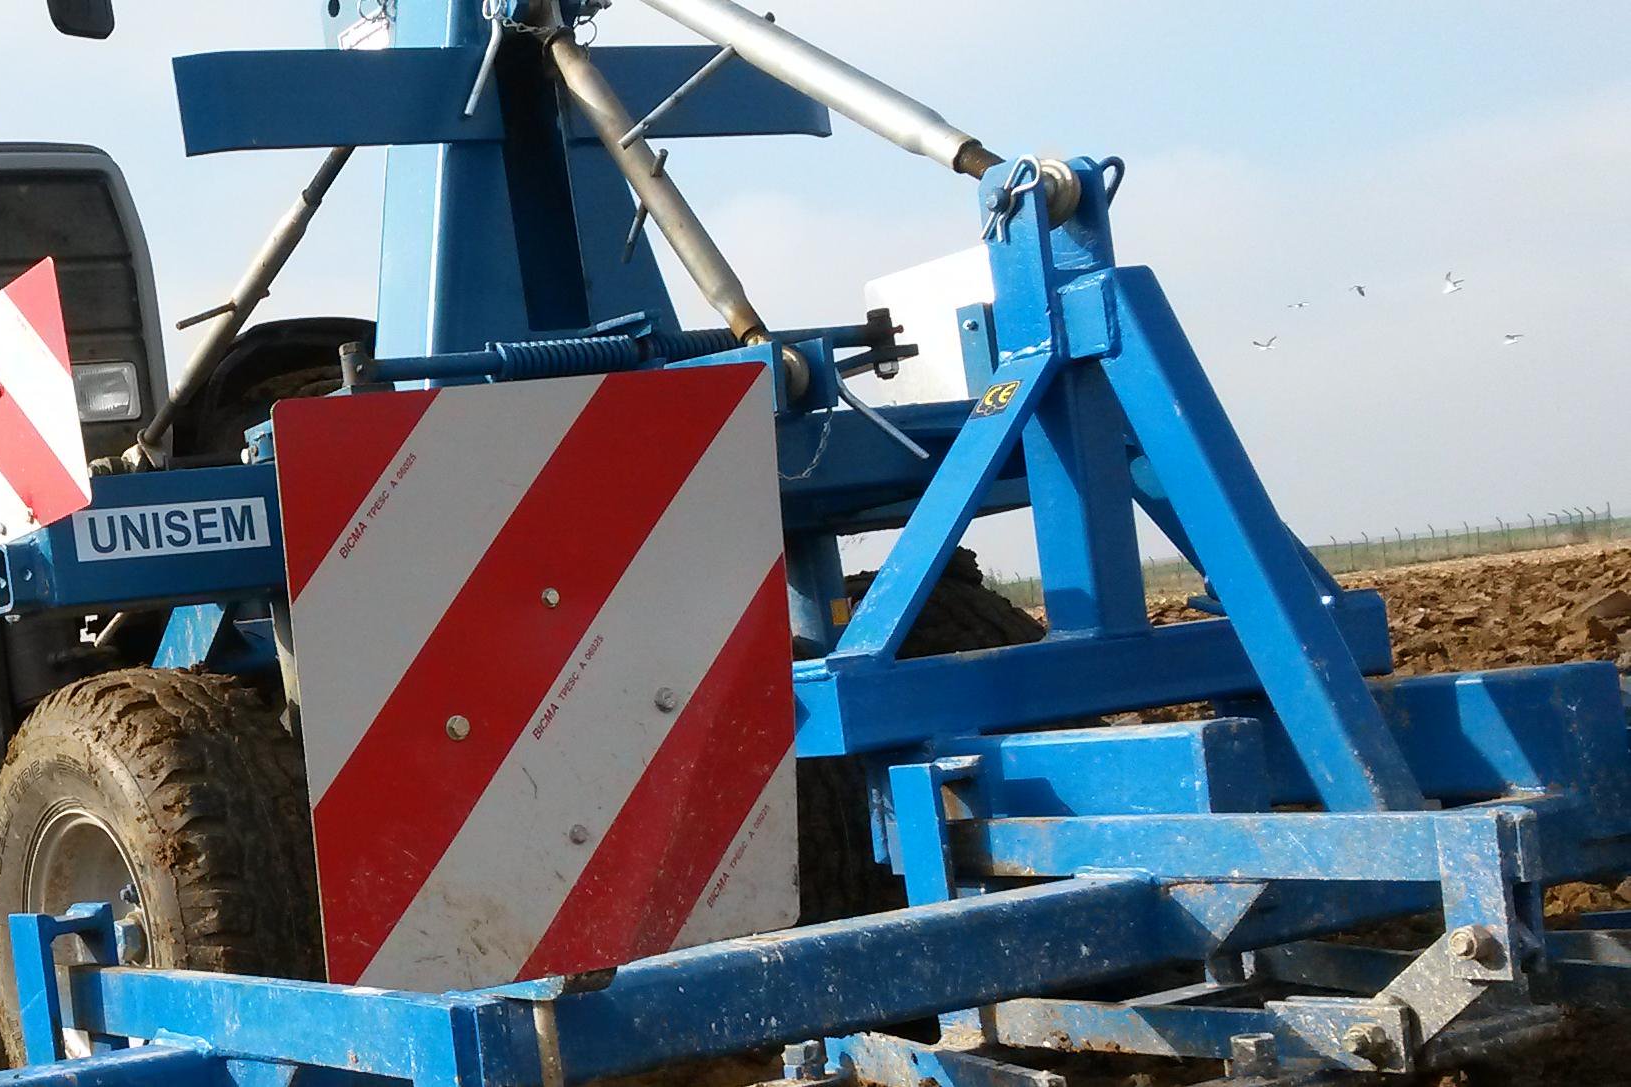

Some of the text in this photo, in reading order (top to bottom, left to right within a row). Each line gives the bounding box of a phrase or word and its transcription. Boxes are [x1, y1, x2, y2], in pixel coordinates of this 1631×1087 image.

[88, 505, 256, 553] UNISEM
[339, 521, 368, 559] BICMA
[366, 490, 389, 519] TPESC
[390, 480, 398, 489] A
[532, 702, 559, 740] BICMA
[706, 871, 730, 909] BICMA
